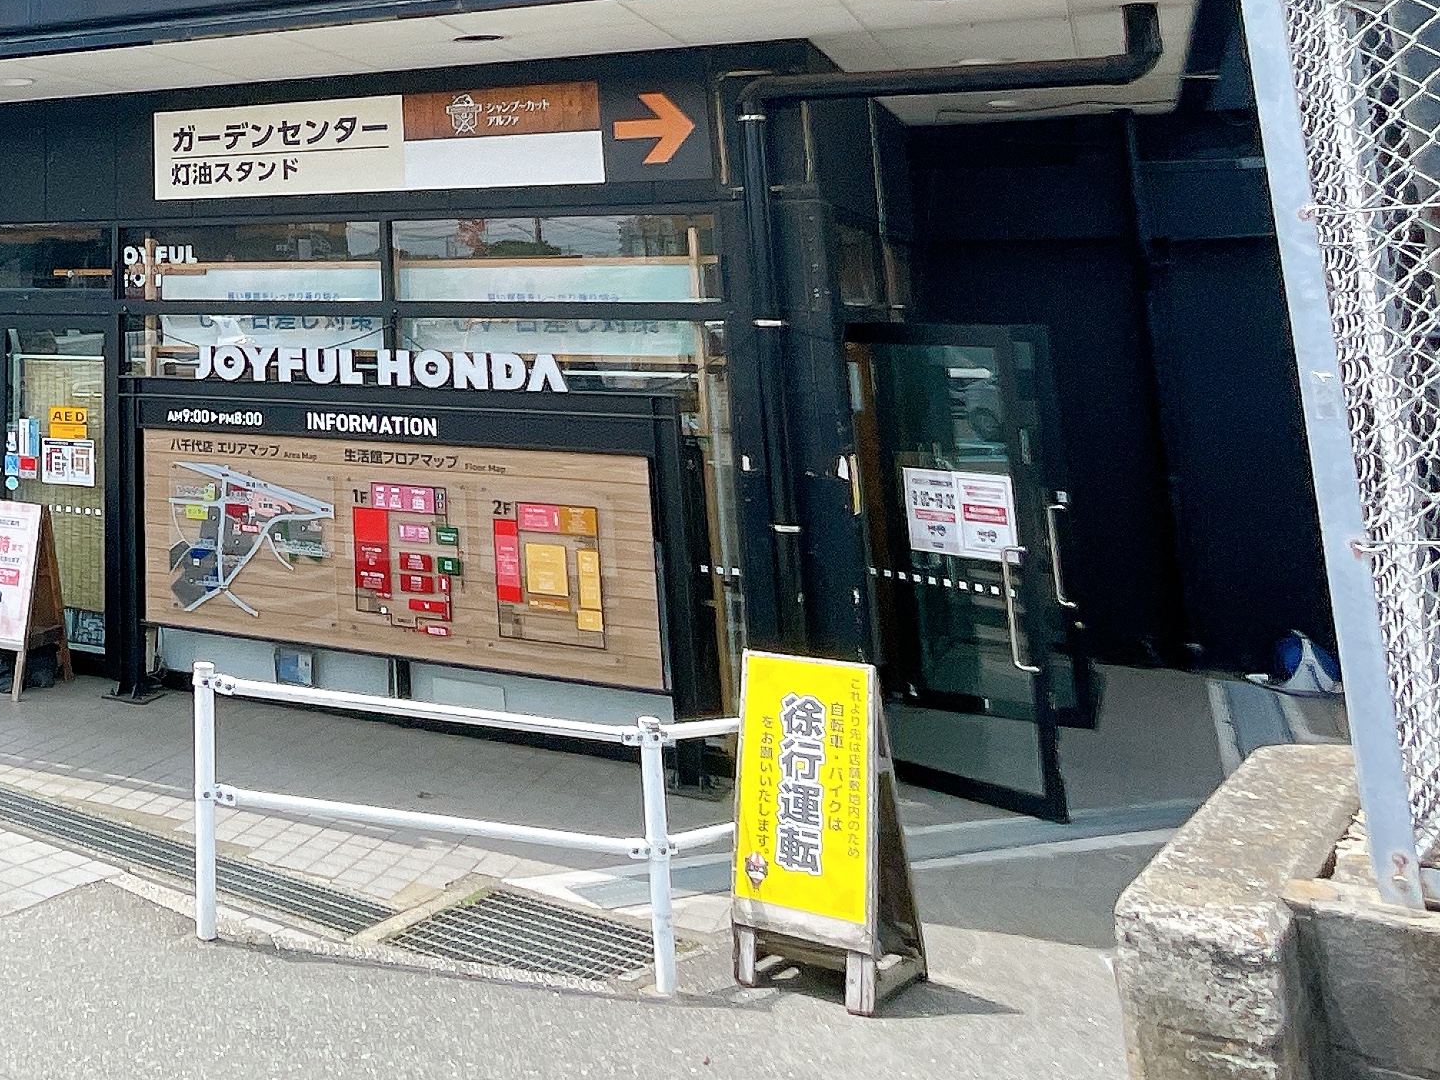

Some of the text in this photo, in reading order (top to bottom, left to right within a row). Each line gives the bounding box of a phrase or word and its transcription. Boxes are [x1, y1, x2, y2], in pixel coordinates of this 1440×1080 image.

[486, 114, 520, 127] アルファ
[171, 117, 390, 152] ガーデンセンター
[171, 158, 300, 186] 灯油スタンド
[195, 345, 568, 393] JOYFUL HONDA
[52, 411, 85, 422] AED
[167, 408, 263, 426] AM9:00 PM8:00
[307, 412, 438, 437] INFORMATION
[171, 438, 213, 453] 八千代店
[217, 441, 280, 458] エリアマップ
[344, 448, 460, 469] 生活館フロアマップ
[352, 488, 368, 504] 1F
[492, 500, 511, 516] 2F
[828, 701, 845, 832] 自転車・バイクは
[757, 714, 774, 857] をお願いいたします。
[777, 694, 826, 874] 徐行運転
